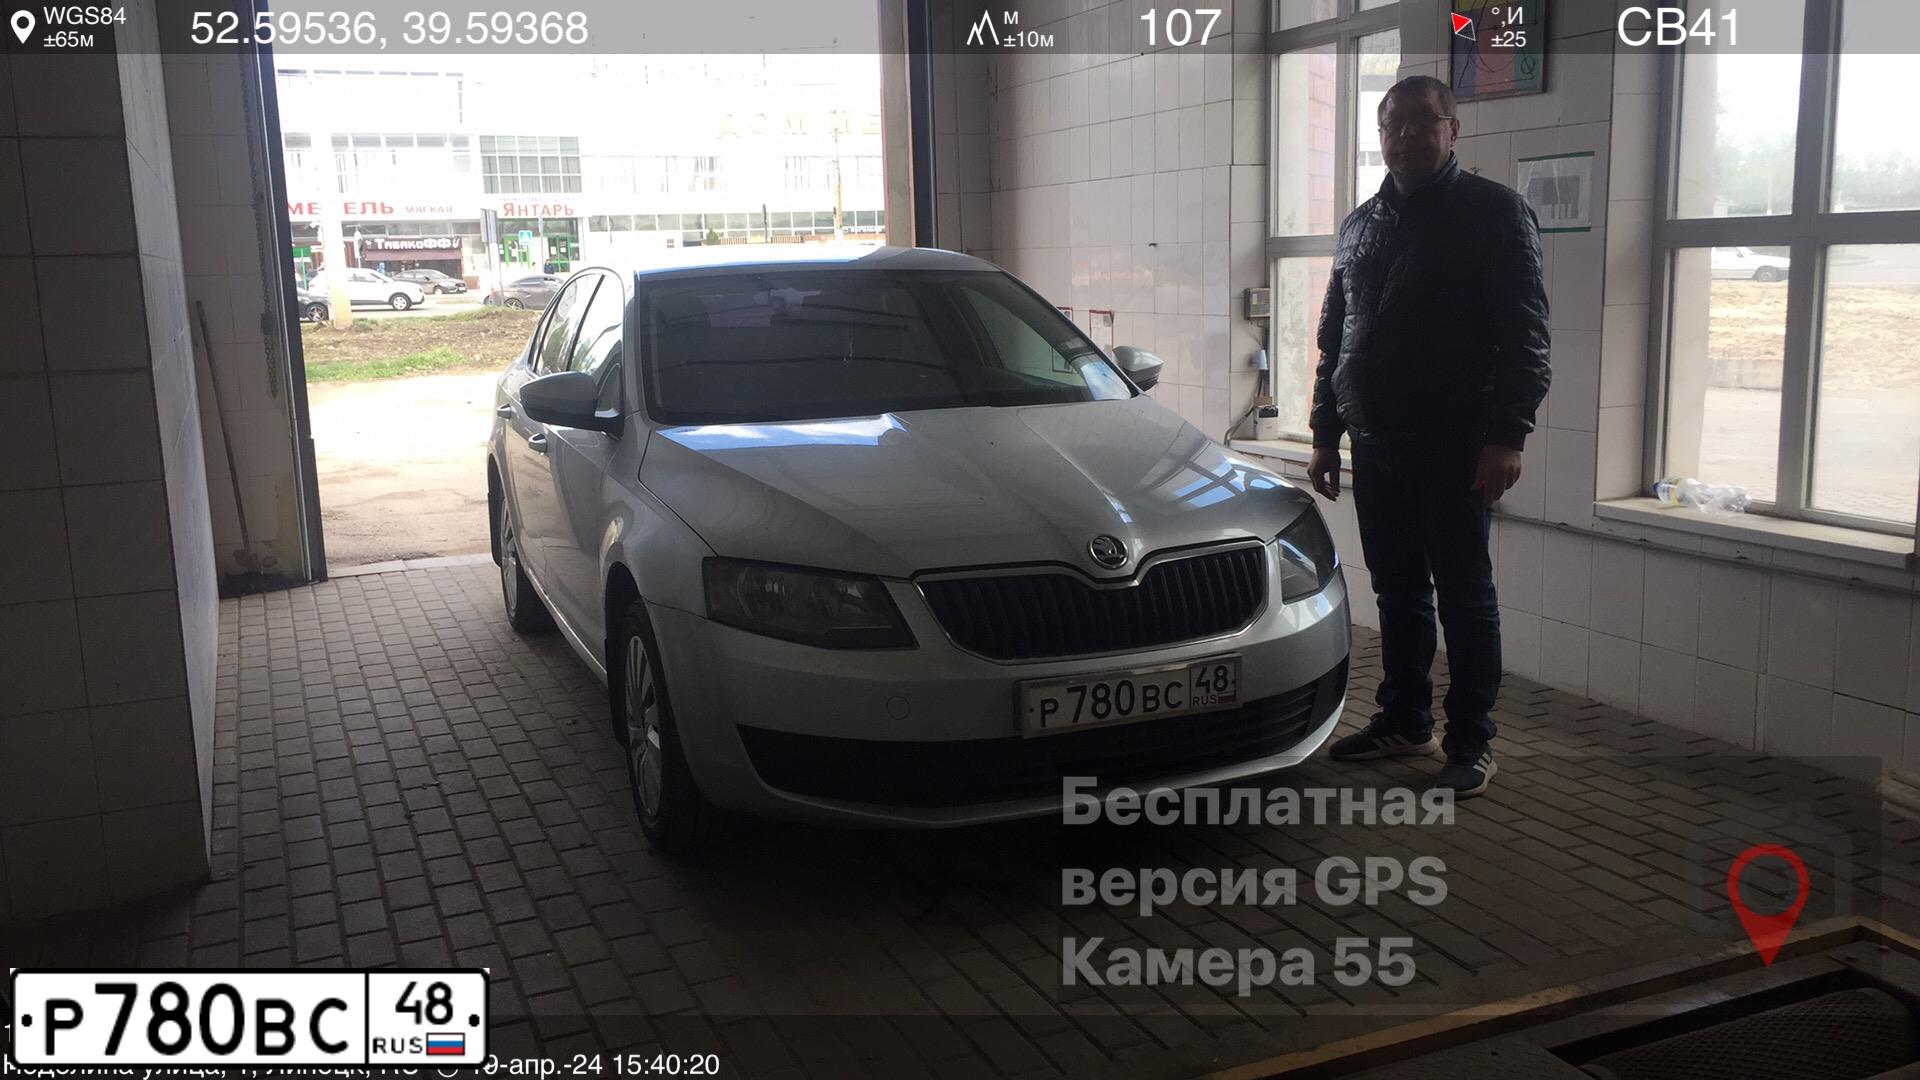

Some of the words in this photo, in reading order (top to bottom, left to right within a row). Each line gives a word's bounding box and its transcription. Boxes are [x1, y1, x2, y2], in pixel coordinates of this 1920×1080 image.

[288, 202, 394, 215] МЕЕЛЬ
[1194, 665, 1229, 694] 48
[1192, 694, 1218, 707] RUS
